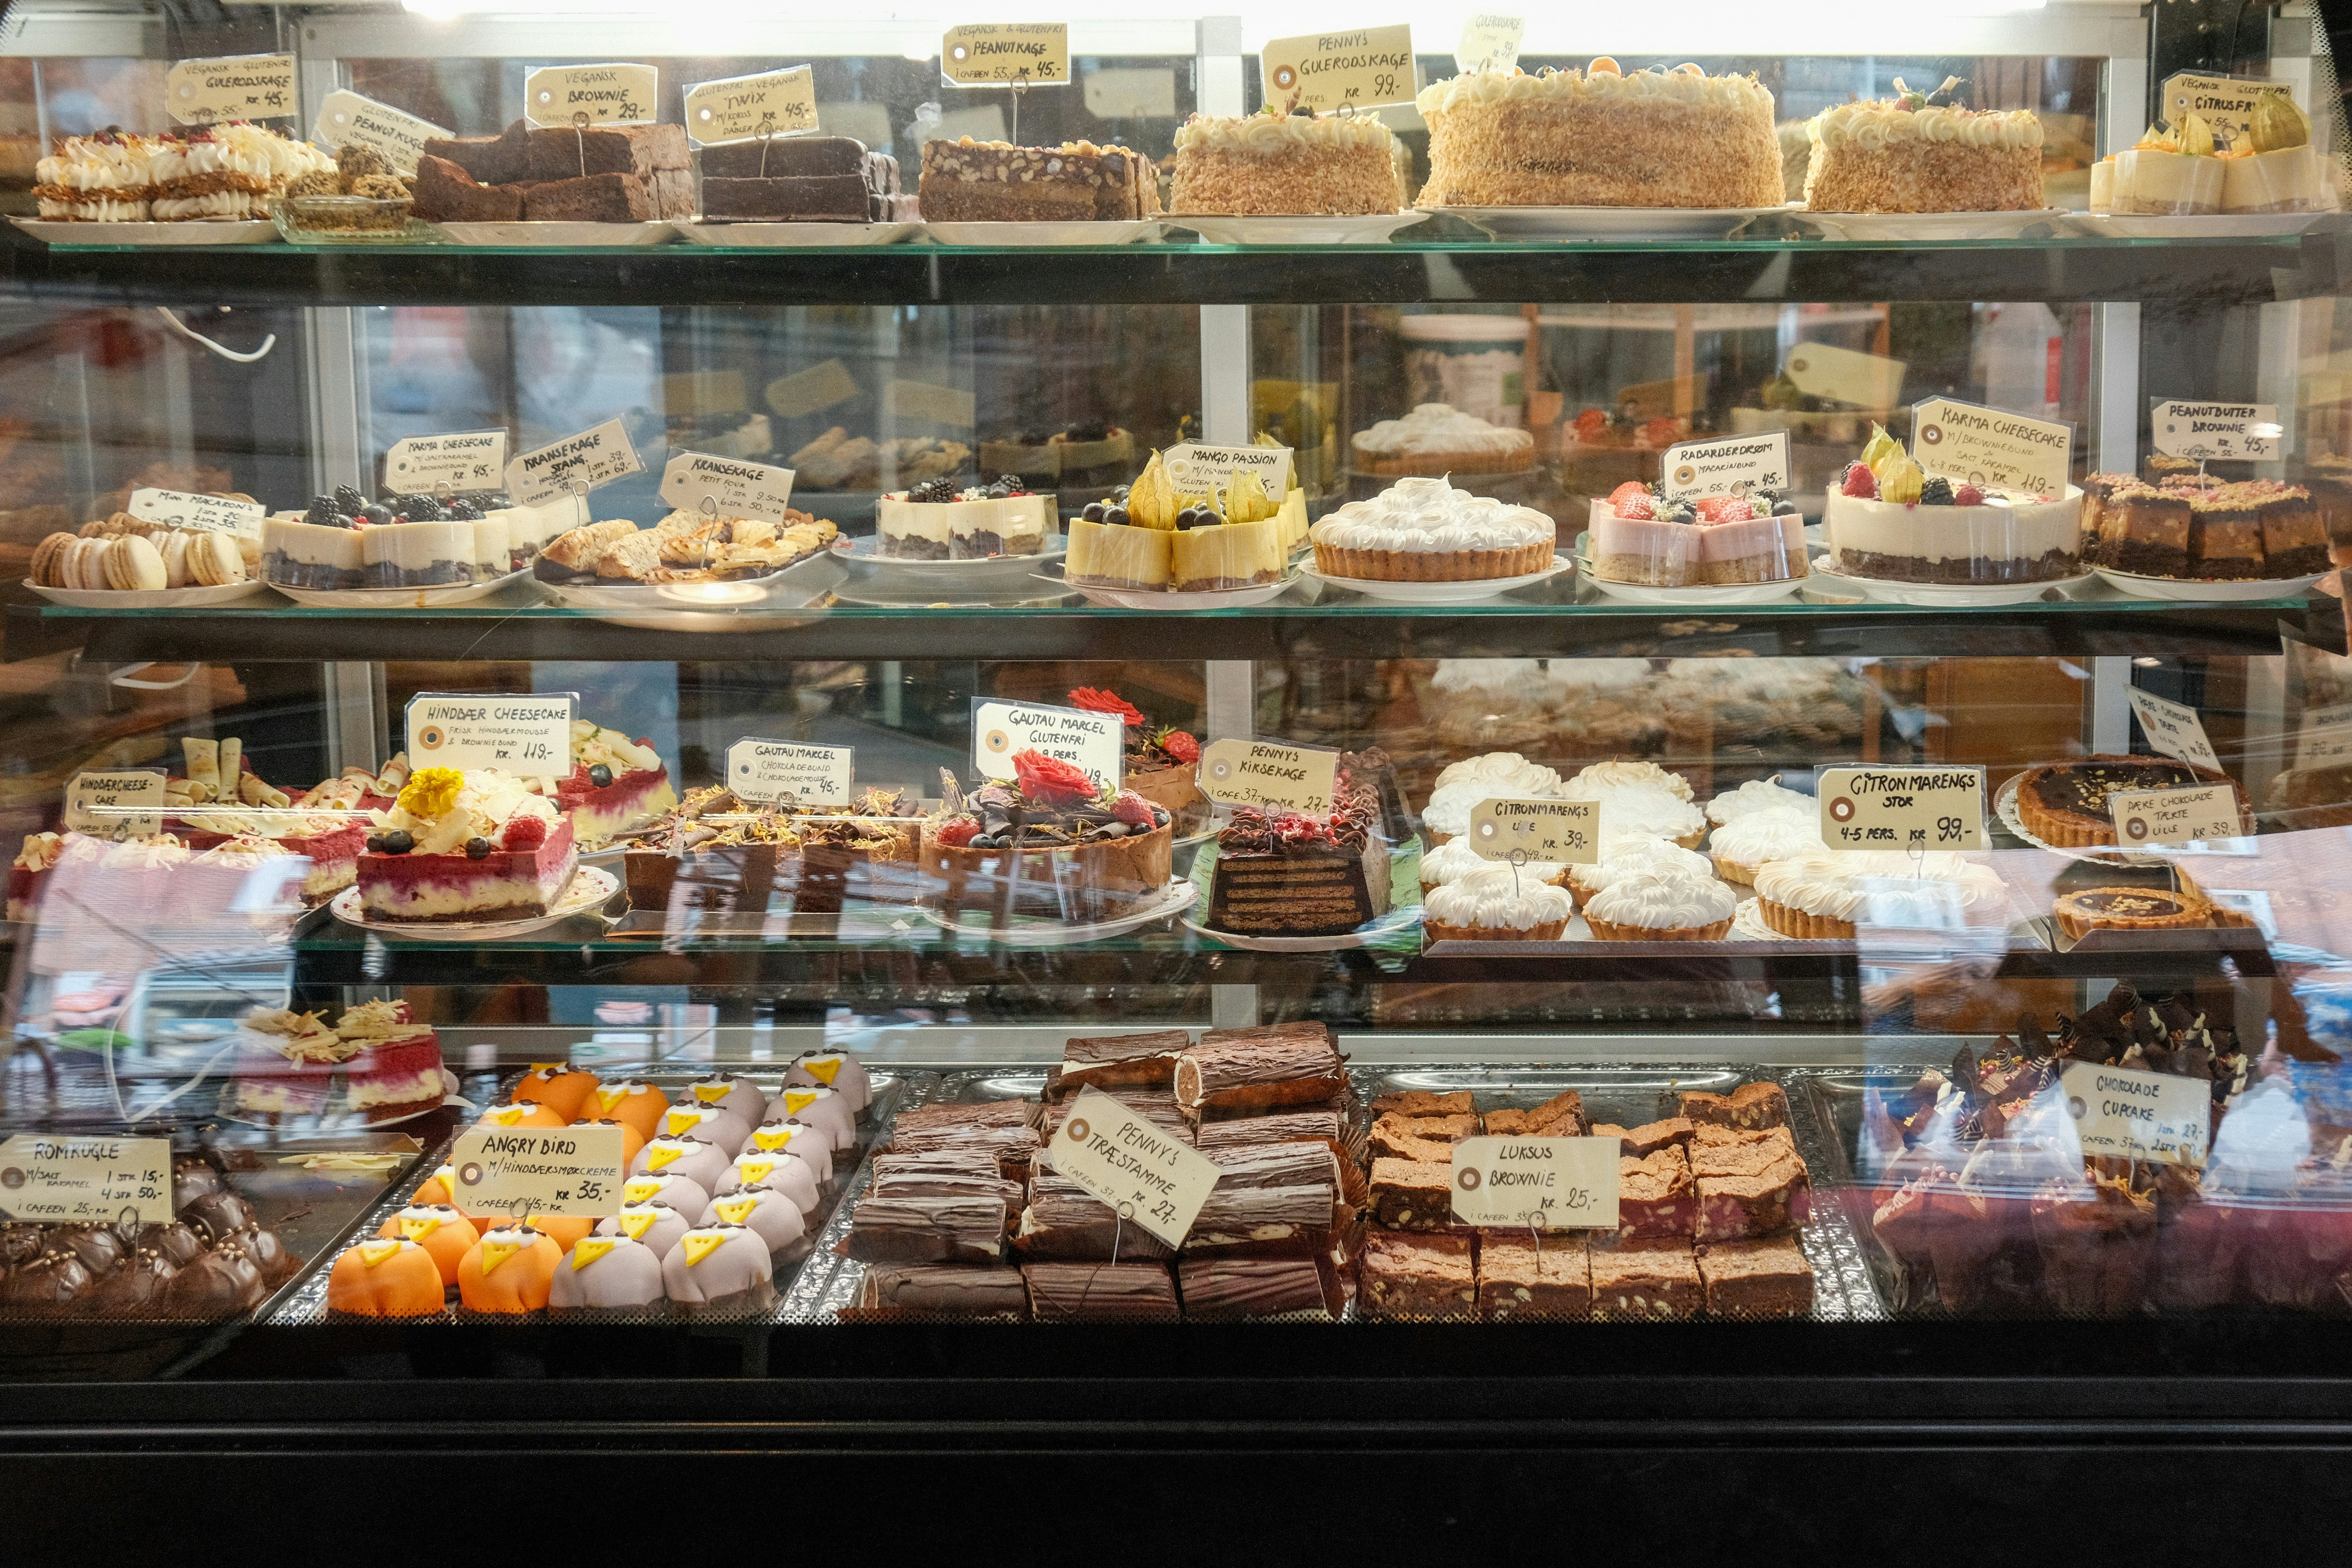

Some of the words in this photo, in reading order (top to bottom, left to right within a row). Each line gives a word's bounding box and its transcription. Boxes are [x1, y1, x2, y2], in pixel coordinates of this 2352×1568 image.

[1476, 14, 1521, 31] GULERODSKAGE
[957, 26, 998, 38] VEGANSK
[1037, 61, 1061, 77] 45,-
[1300, 53, 1408, 75] GULERODSKAGE
[205, 75, 291, 88] GULERODSKAGE
[565, 71, 616, 86] VEGANSK
[756, 75, 799, 89] VEGANSK
[1375, 74, 1400, 96] 99,-
[2181, 78, 2220, 90] VEGANSK
[1942, 407, 1989, 430] KARMA
[1994, 420, 2066, 448] CHEESECAKE
[409, 442, 438, 452] KARMA
[443, 437, 493, 450] CHEESECAKE
[1680, 443, 1773, 461] RABARDERDRØM
[2244, 436, 2269, 455] 45,-
[1191, 450, 1228, 465] MANGO
[473, 464, 495, 477] 45,-
[691, 458, 764, 481] KRANSEKAGE
[723, 479, 746, 488] FOUR
[1762, 472, 1782, 486] 45,-
[494, 707, 567, 721] CHEESECAKE
[1009, 710, 1056, 727] GAUTAU
[1061, 718, 1106, 735] MARCEL
[755, 746, 794, 757] GAUTAU
[796, 748, 835, 760] MARCEL
[95, 795, 117, 806] CAKE
[1882, 796, 1914, 808] STOR
[2161, 790, 2213, 807] CHOKOLADE
[1841, 827, 1863, 841] 4-5
[1866, 828, 1897, 841] PERS.
[1937, 816, 1972, 842] 99,-
[2193, 827, 2205, 840] KR
[2096, 1075, 2160, 1098] CHOKOLADE
[2103, 1100, 2154, 1122] CUPCAKE
[34, 1142, 120, 1161] ROMKUGLE
[481, 1135, 537, 1158] ANGRY
[1499, 1145, 1553, 1161] LUKSUS
[1087, 1132, 1176, 1196] TRÆSTAMME
[1067, 1166, 1098, 1189] CAFEEN
[576, 1180, 611, 1202] 35,-
[26, 1204, 66, 1213] CAFEEN
[1540, 1196, 1558, 1209] KR.
